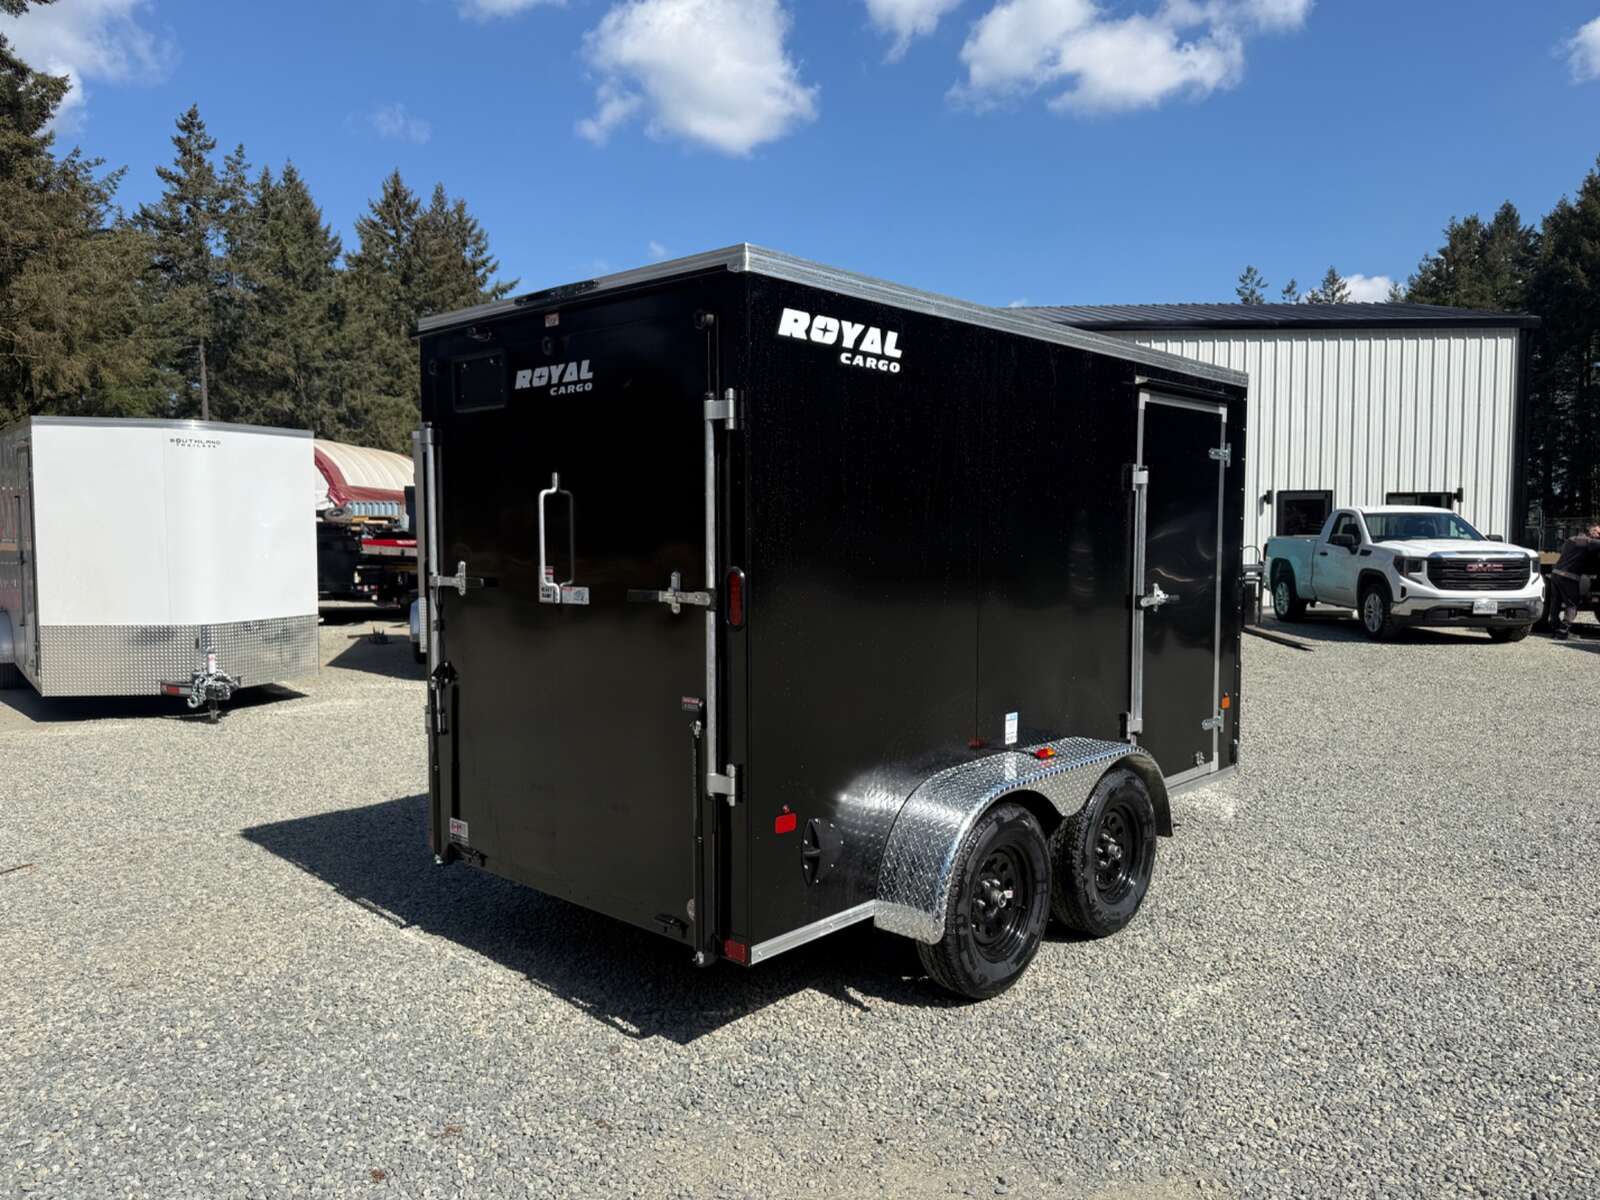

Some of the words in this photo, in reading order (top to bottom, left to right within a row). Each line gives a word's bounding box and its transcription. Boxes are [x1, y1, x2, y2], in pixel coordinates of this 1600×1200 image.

[778, 307, 902, 358] ROYAL
[840, 352, 901, 373] CARGO
[515, 359, 593, 390] ROYAL
[550, 382, 593, 396] CARGO
[1466, 563, 1504, 572] GMC
